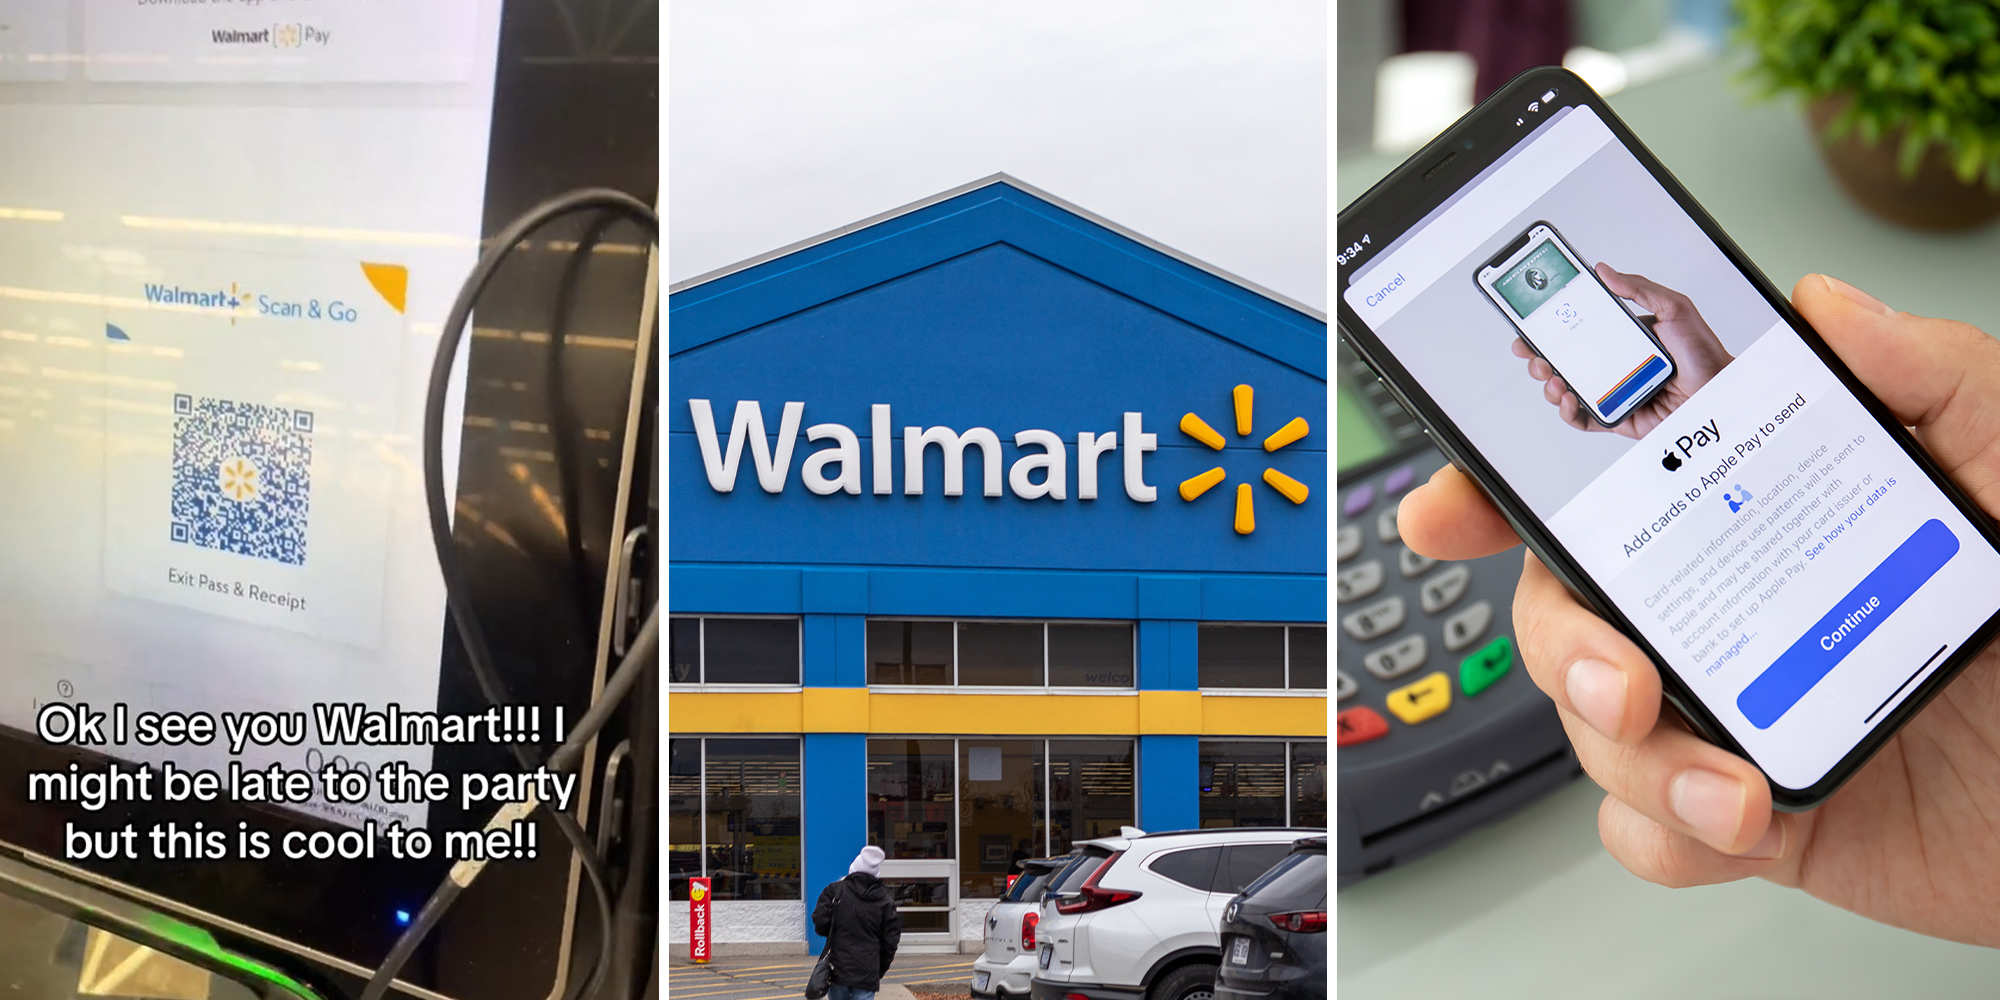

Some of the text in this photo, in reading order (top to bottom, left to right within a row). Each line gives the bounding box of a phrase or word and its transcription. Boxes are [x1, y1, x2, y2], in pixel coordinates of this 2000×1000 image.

[211, 25, 330, 46] Walmart Pay
[1337, 241, 1364, 266] 9:34
[258, 294, 303, 318] Scan
[307, 298, 323, 319] &
[327, 300, 358, 323] Go
[1365, 272, 1407, 308] Cancel
[688, 398, 1158, 502] Walmart
[1674, 418, 1721, 460] Pay
[1623, 392, 1807, 559] Add cards to Apple Pay to send
[1643, 444, 1829, 609] Card-related information, location, device
[1656, 434, 1866, 623] settings, and device use patterns will be sent to
[1668, 478, 1843, 637] Apple and may be shared together with
[1681, 473, 1874, 650] account information with your card issuer or
[1691, 476, 1897, 664] bank to set up Apple Pay. See how your data is
[168, 567, 307, 612] Exit Pass & Receipt
[1820, 596, 1880, 651] Continue
[1705, 631, 1758, 677] managed...
[694, 903, 706, 957] Rollback
